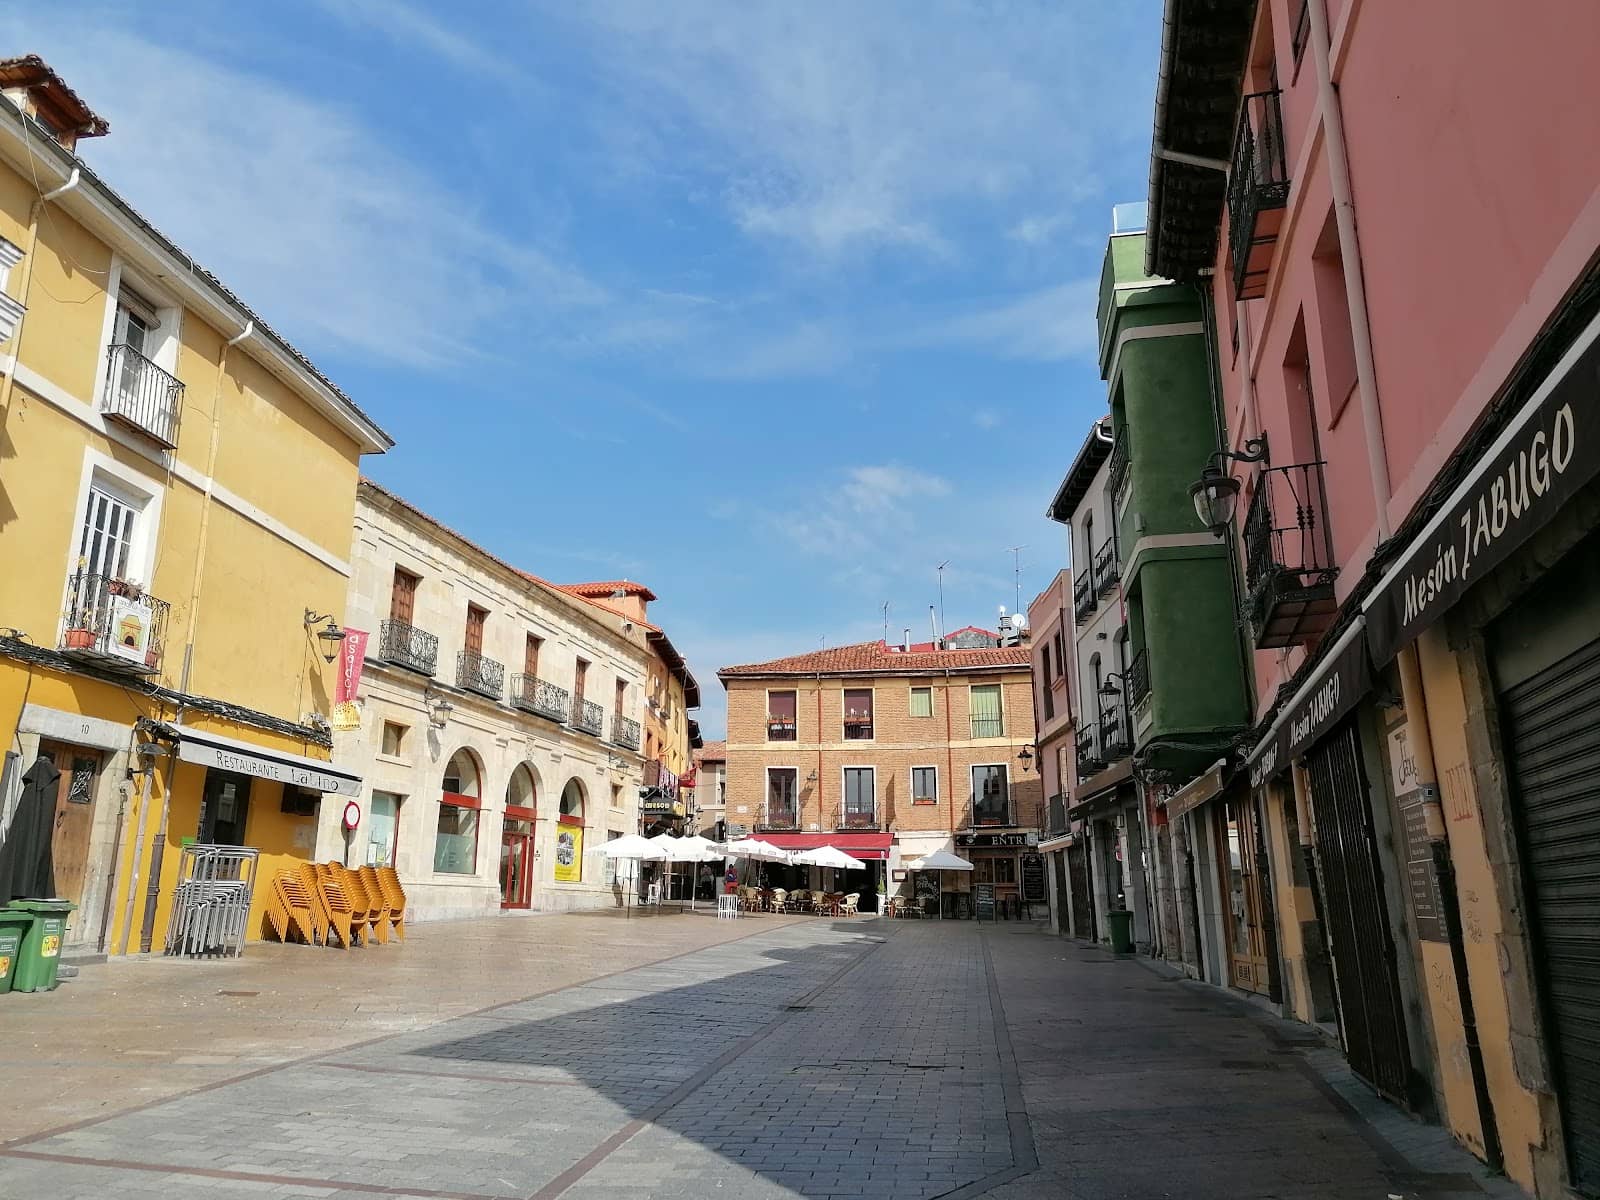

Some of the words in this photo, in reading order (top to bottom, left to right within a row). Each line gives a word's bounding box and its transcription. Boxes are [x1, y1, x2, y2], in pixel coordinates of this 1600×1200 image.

[1402, 543, 1458, 627] Mesón
[1460, 401, 1576, 581] JABUGO
[1308, 671, 1340, 738] JABUGO
[216, 750, 280, 779] RESTAURANTE
